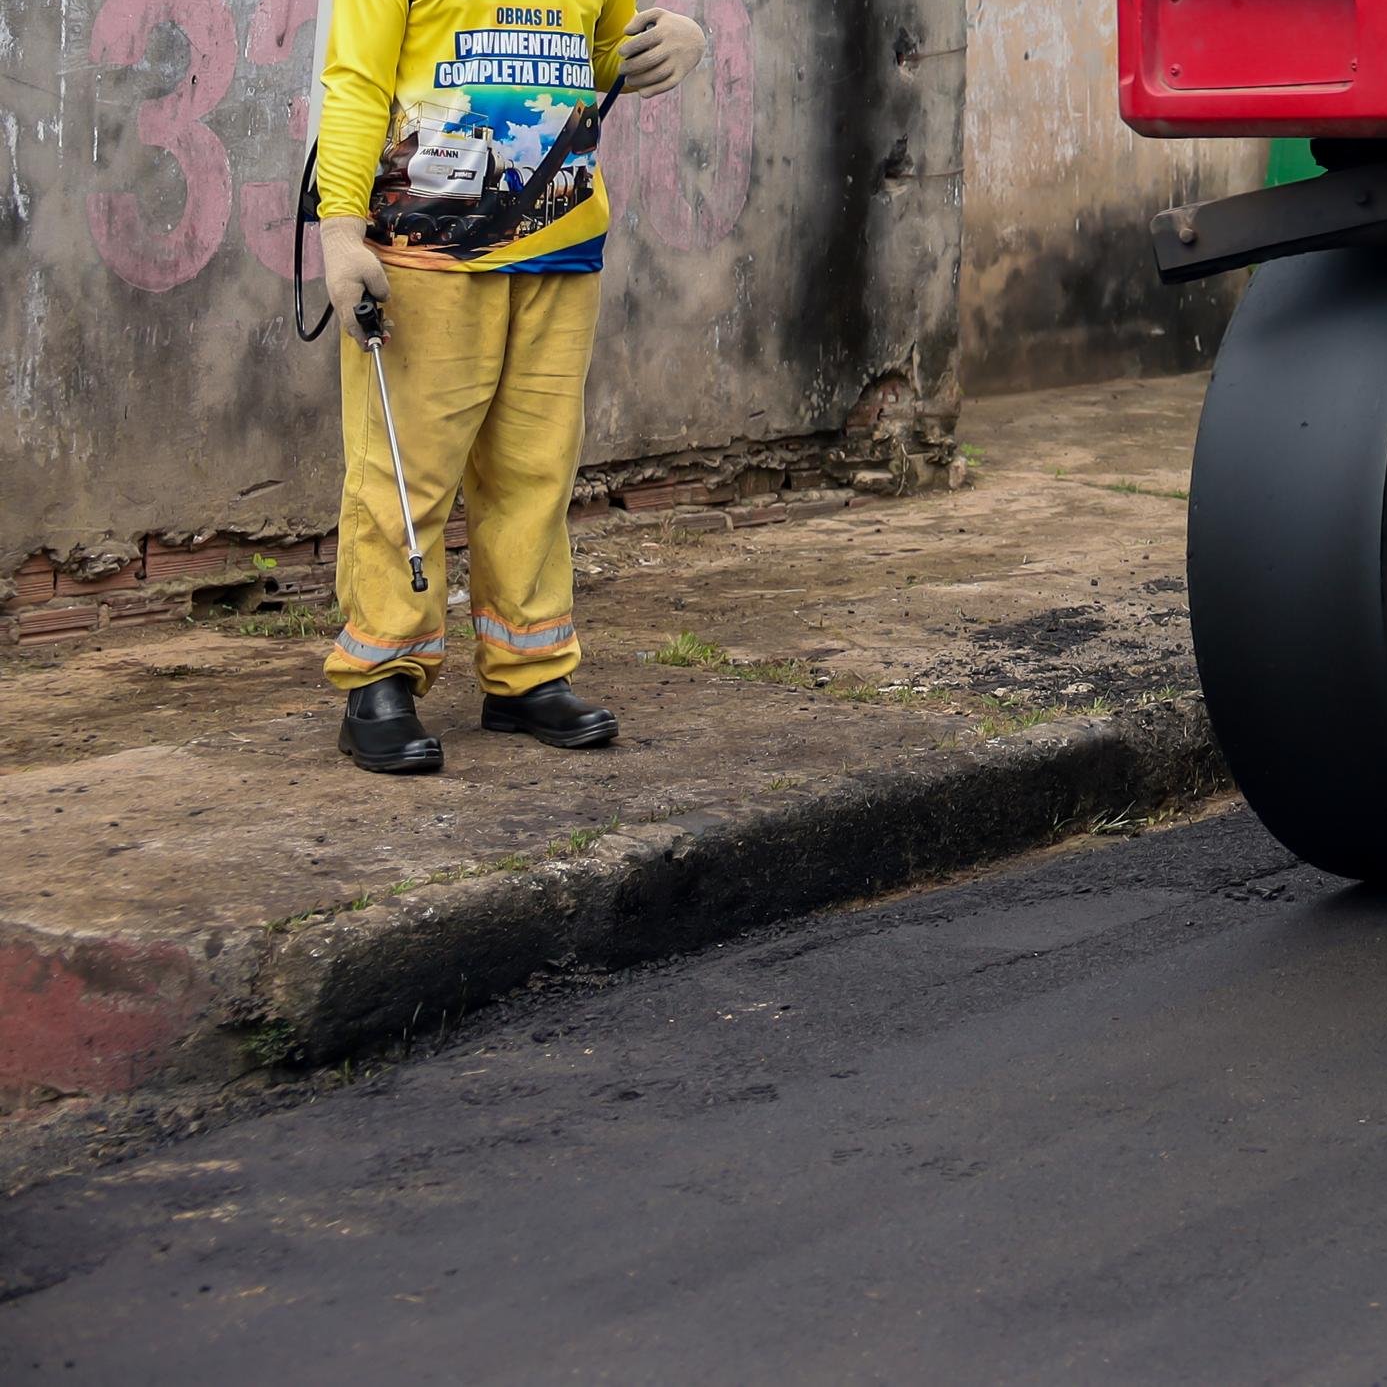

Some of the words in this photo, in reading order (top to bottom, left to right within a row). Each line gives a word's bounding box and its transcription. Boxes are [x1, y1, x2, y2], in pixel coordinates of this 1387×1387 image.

[496, 7, 542, 26] OBRAS
[546, 9, 562, 27] DE
[459, 32, 589, 60] PAVIMENTAÇÃO
[439, 60, 535, 87] COMPLETA
[537, 62, 560, 85] DE
